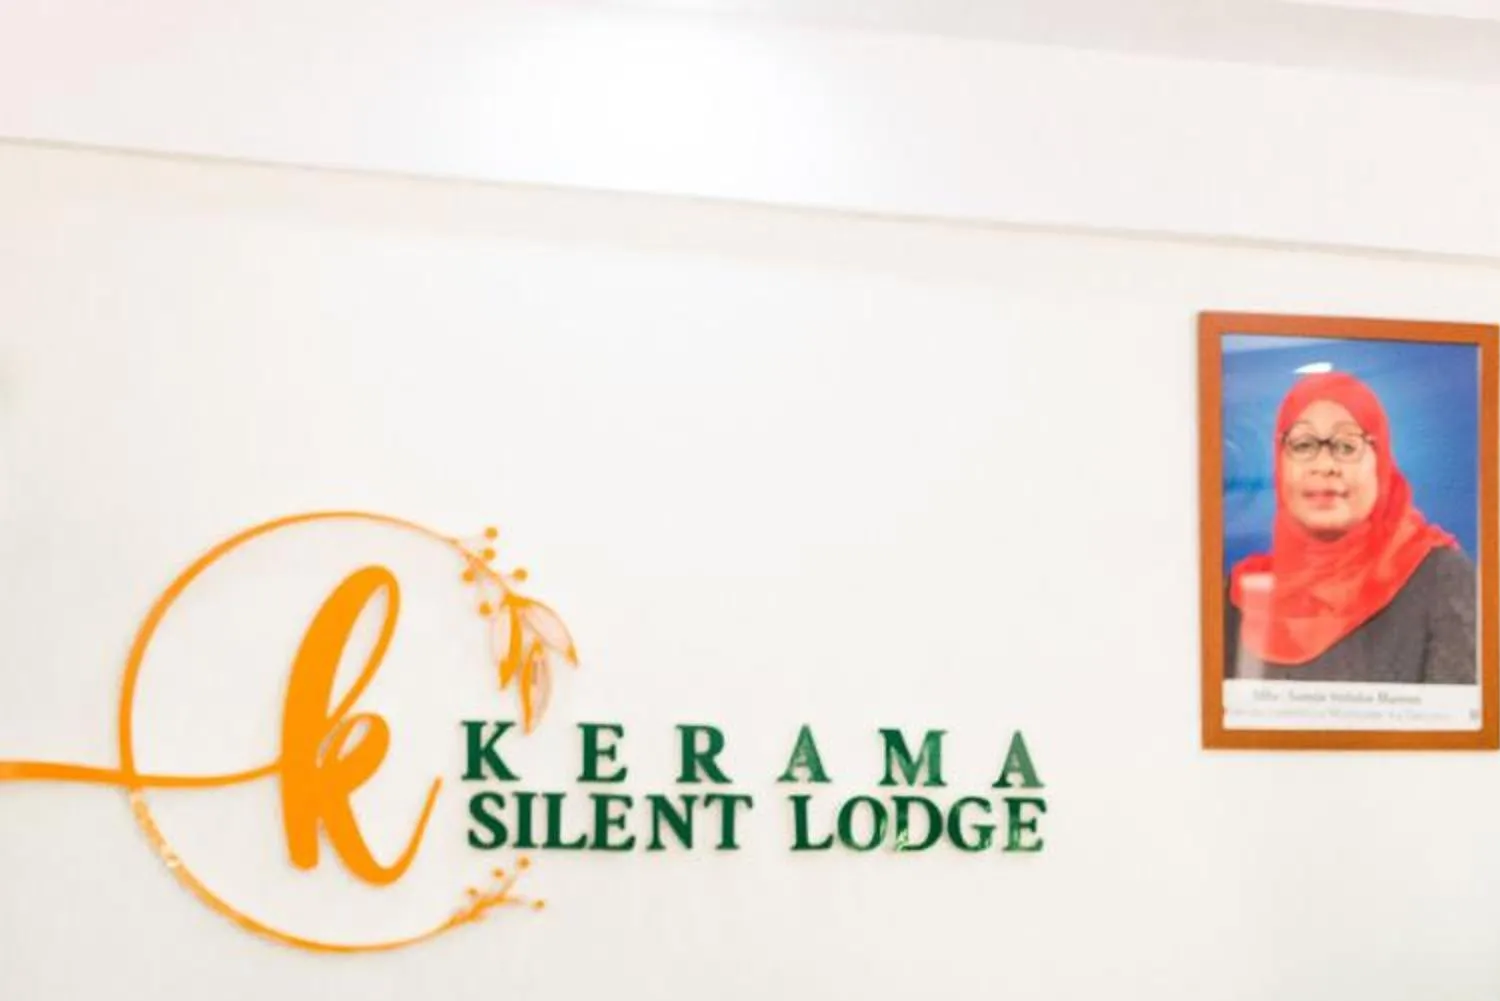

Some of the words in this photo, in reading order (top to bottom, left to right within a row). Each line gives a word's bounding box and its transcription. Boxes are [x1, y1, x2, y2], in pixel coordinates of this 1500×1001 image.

[463, 720, 1045, 789] KERAMA
[468, 792, 753, 851] SILENT
[789, 795, 1047, 852] LODGE
